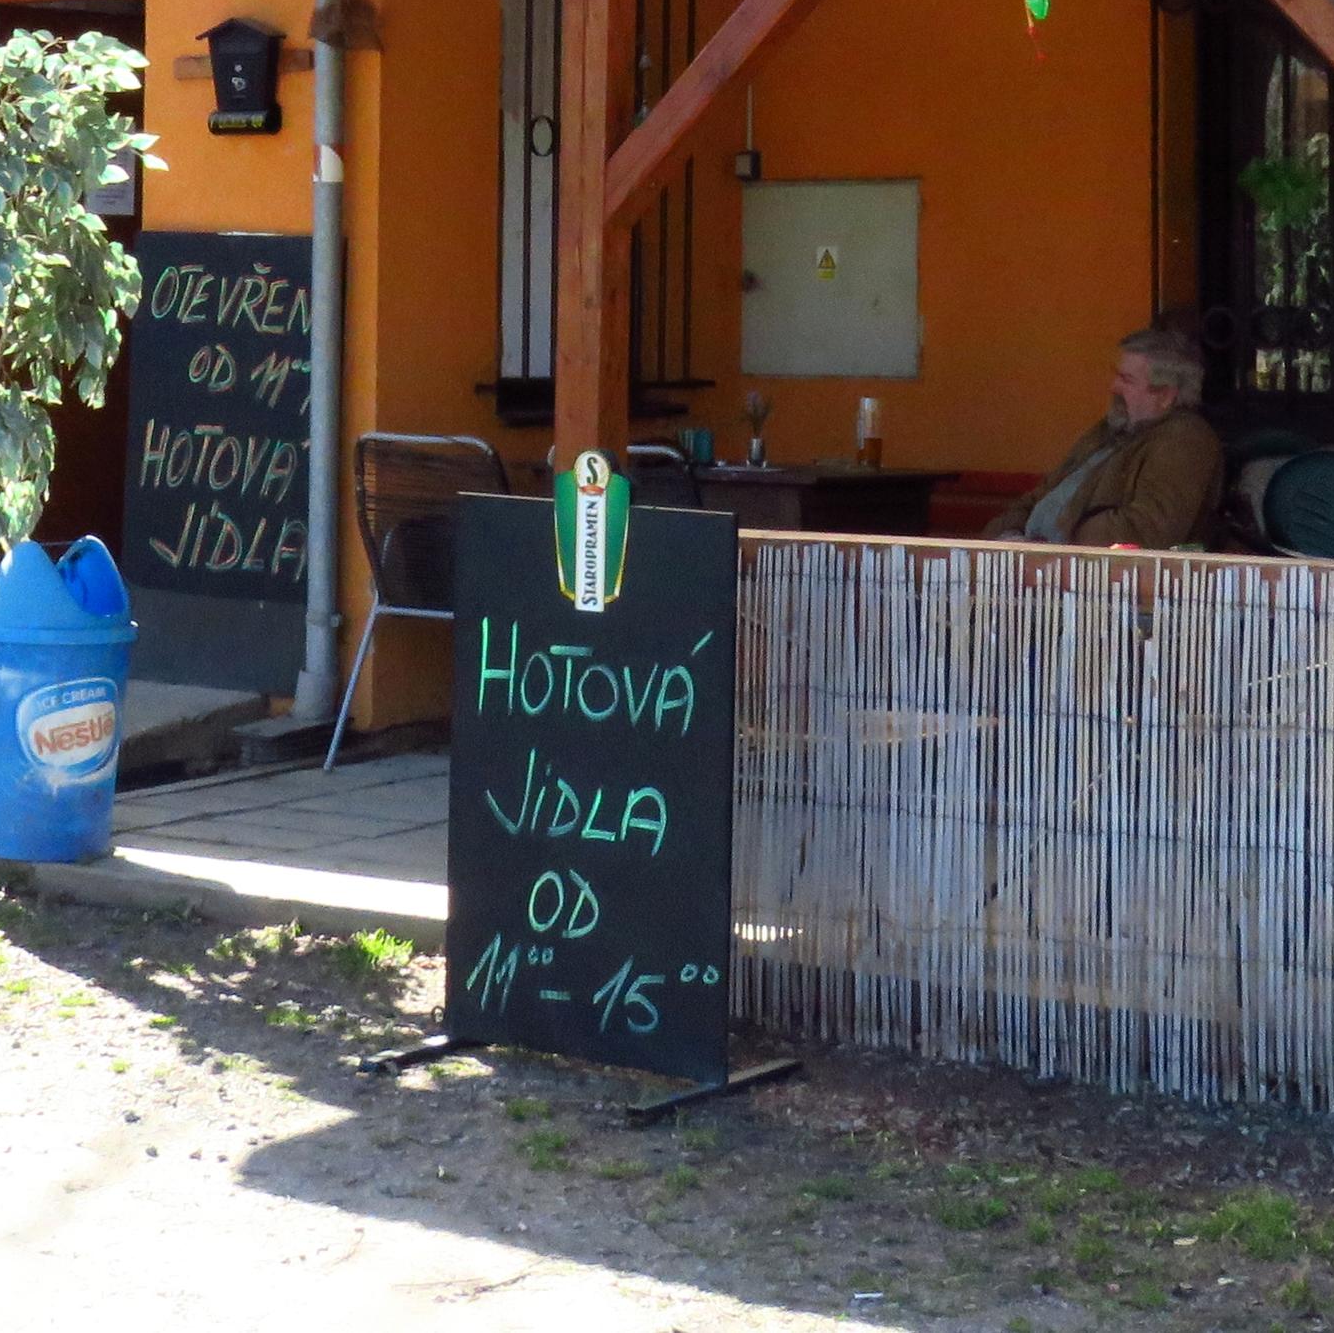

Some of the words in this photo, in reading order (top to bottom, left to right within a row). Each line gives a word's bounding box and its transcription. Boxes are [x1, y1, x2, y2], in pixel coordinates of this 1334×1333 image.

[151, 262, 311, 334] OTEVŘEN
[189, 343, 235, 392] OD
[581, 500, 599, 607] STAROPRAMEN
[36, 694, 58, 712] ICE
[61, 685, 107, 705] CREAM
[477, 616, 714, 738] HOTOVÁ
[33, 713, 114, 757] Nestlé
[528, 869, 600, 940] OD
